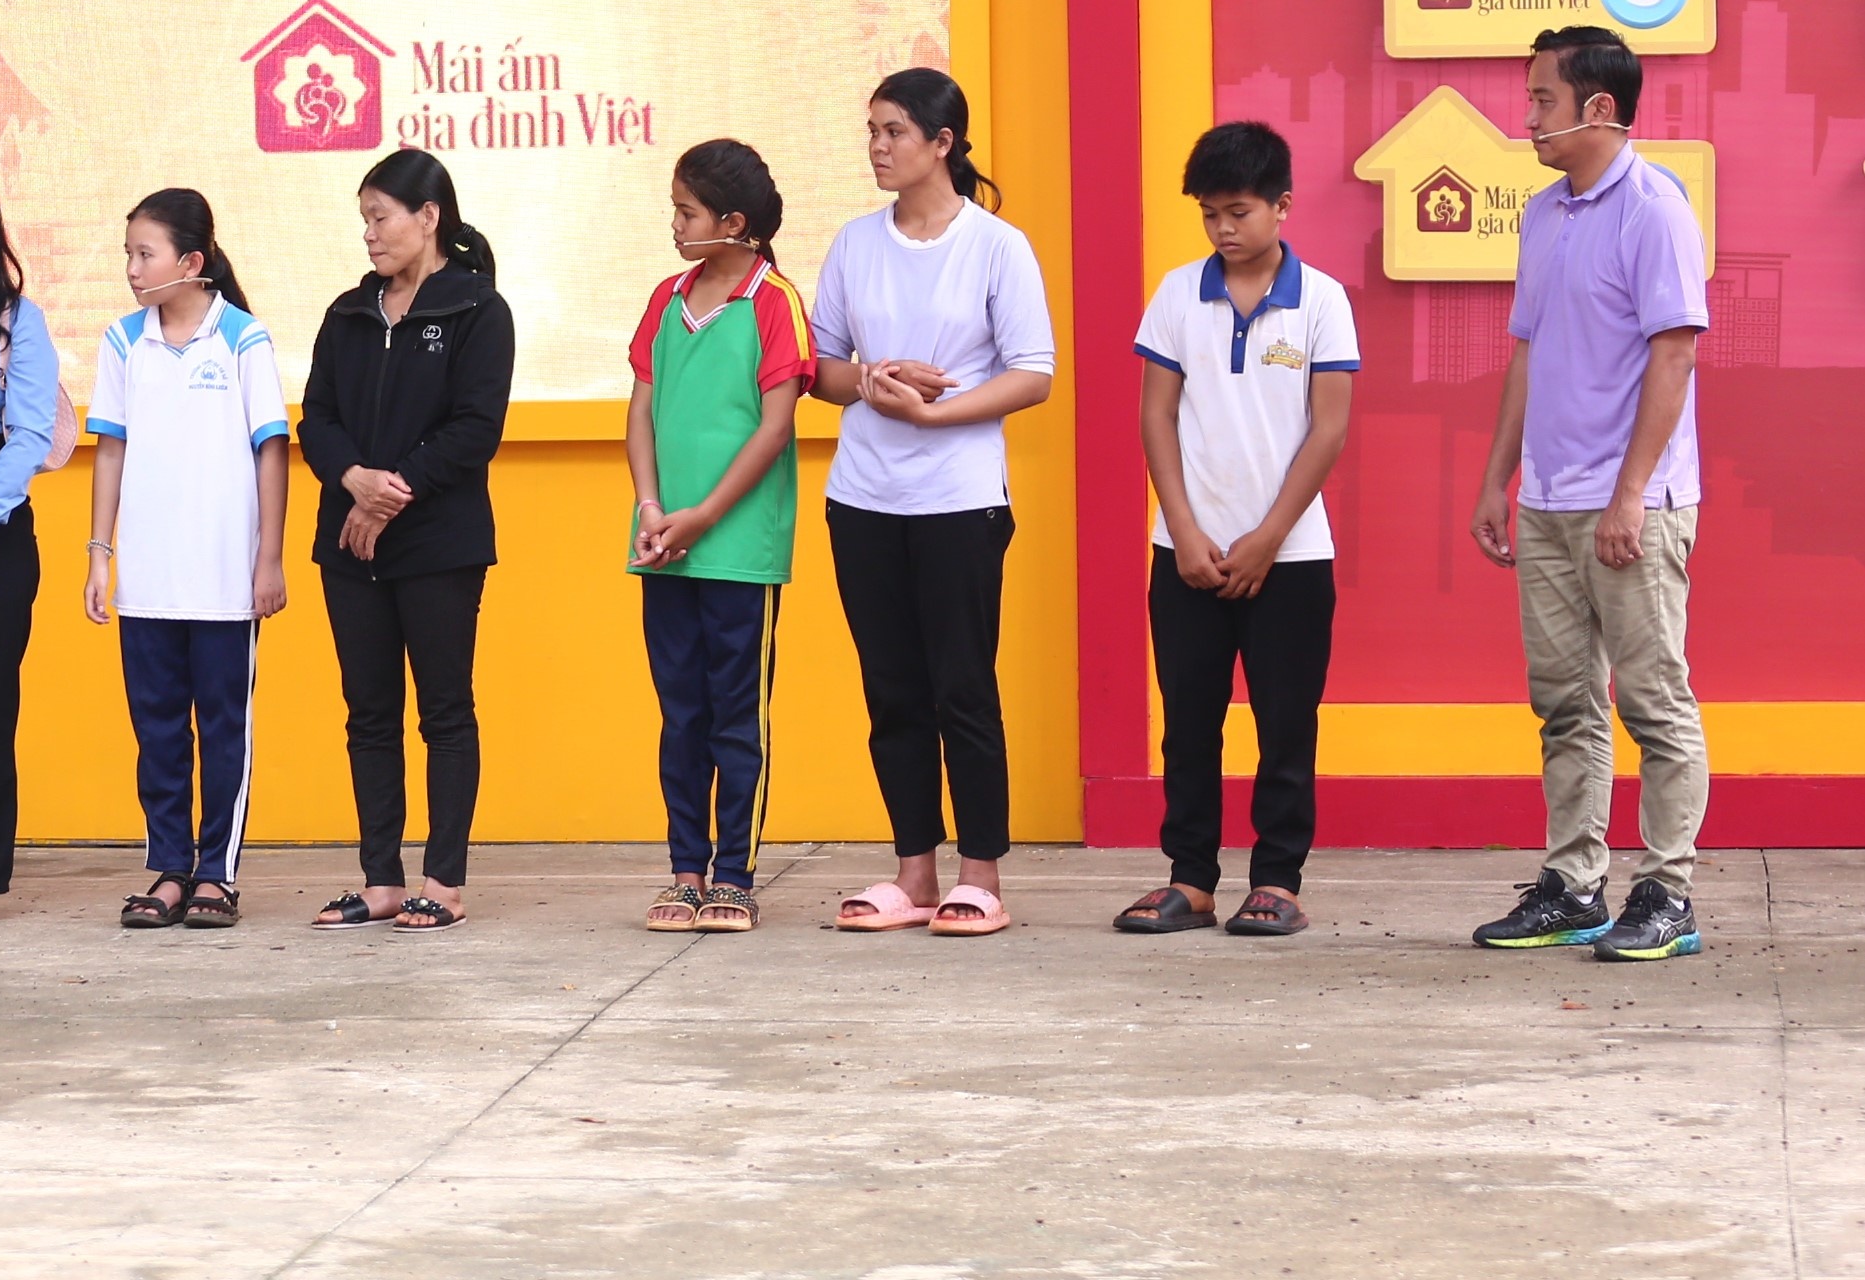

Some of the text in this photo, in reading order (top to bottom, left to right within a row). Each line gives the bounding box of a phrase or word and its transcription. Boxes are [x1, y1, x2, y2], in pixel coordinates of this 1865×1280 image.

[412, 36, 561, 95] Mái ấm
[396, 92, 657, 154] gia đình Việt
[1484, 185, 1516, 209] Mái
[1477, 213, 1504, 240] gia
